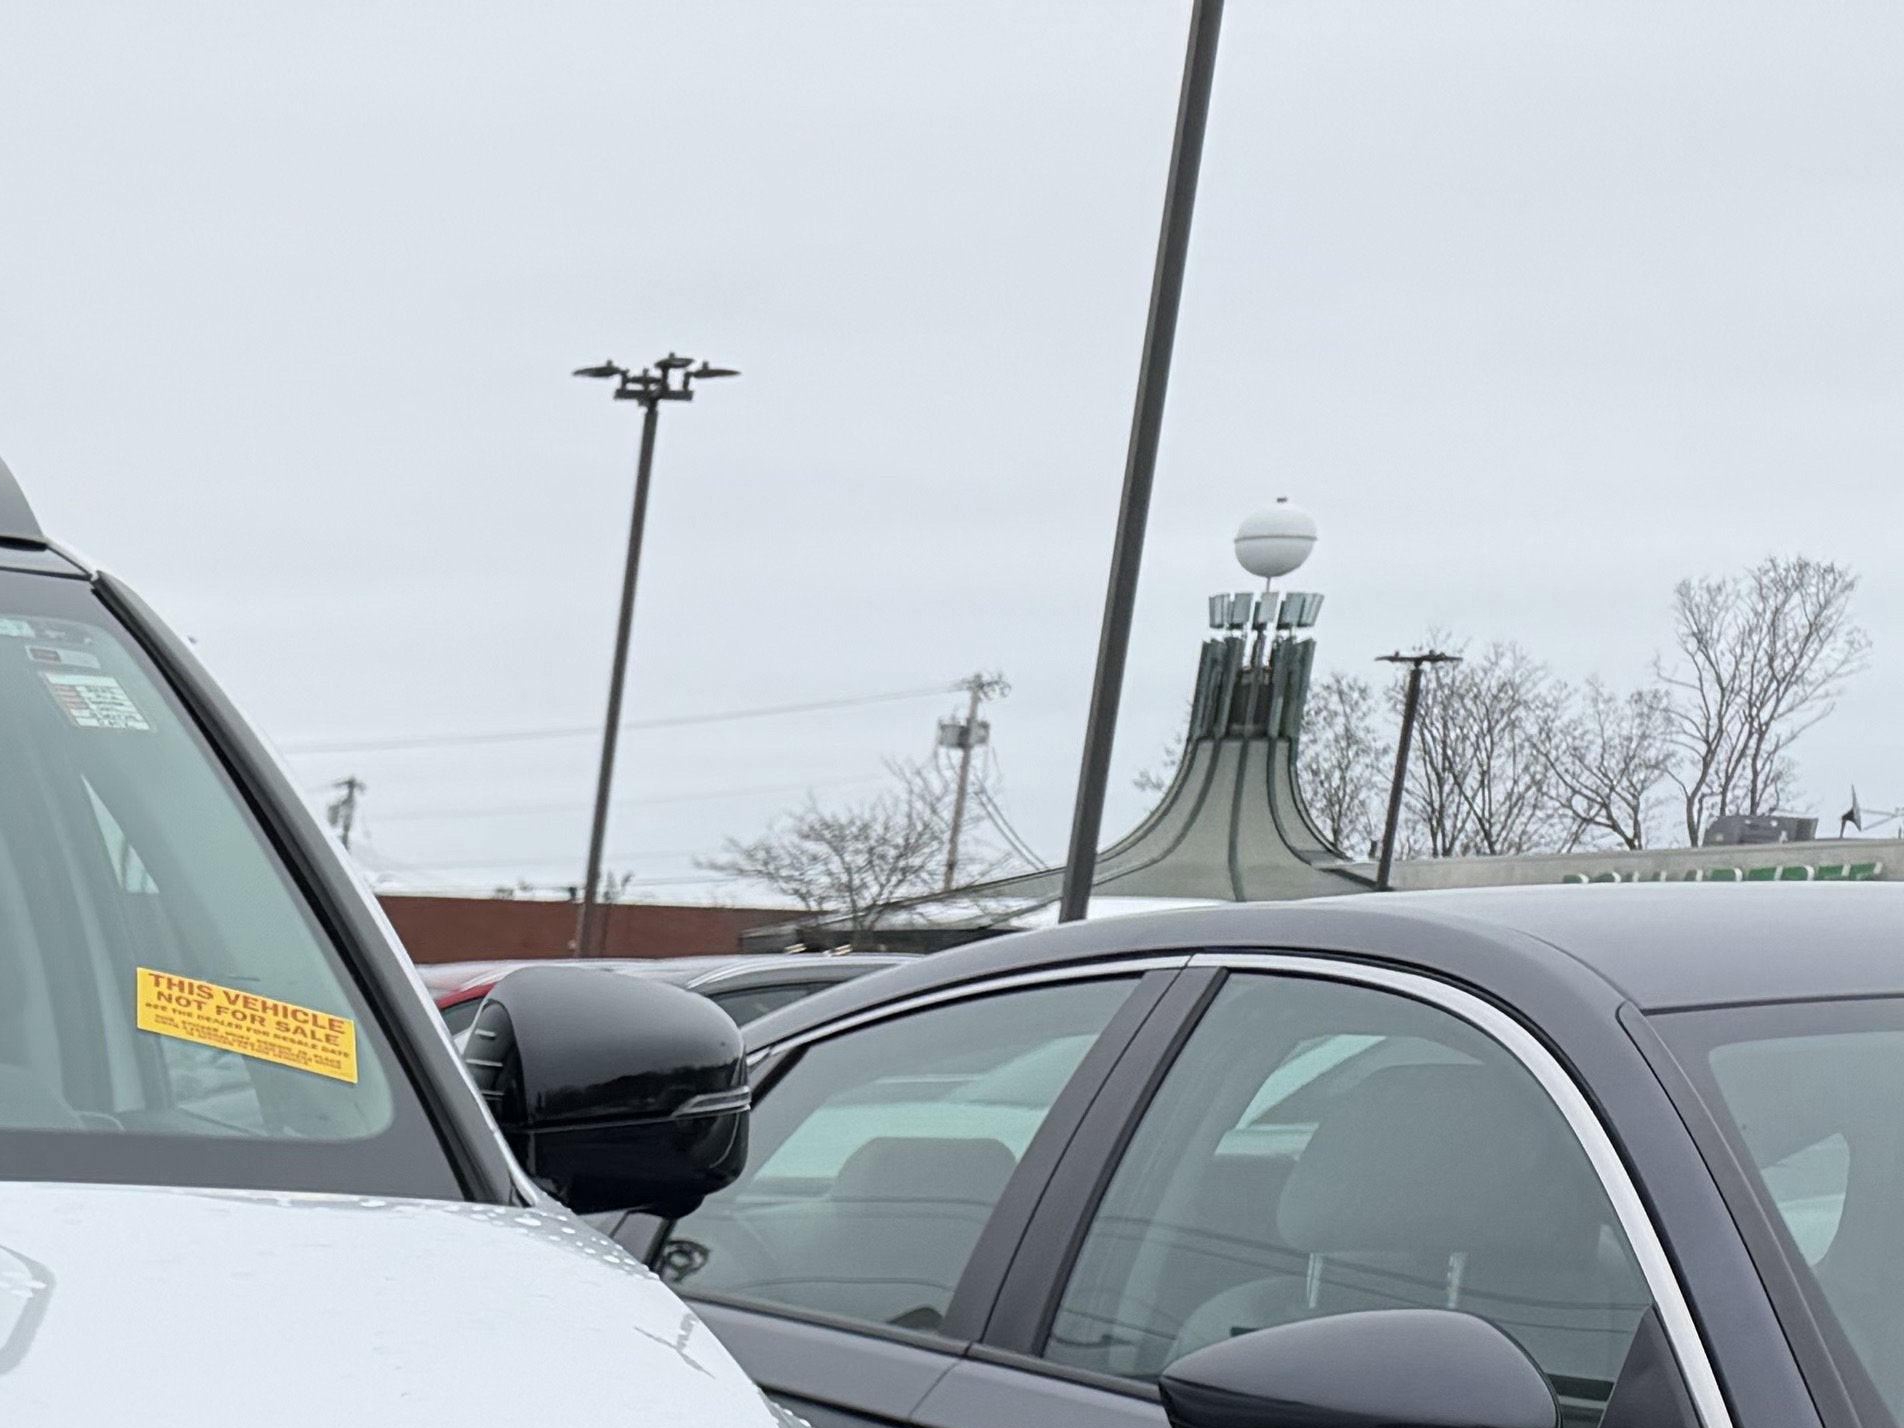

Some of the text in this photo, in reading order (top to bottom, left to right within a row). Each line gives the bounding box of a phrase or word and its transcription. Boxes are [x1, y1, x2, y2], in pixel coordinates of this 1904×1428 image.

[148, 972, 345, 1034] THIS VEHICLE
[156, 991, 340, 1047] NOT FOR SALE
[172, 1008, 193, 1019] THE
[197, 1013, 242, 1031] DEALER
[246, 1024, 270, 1037] FOR
